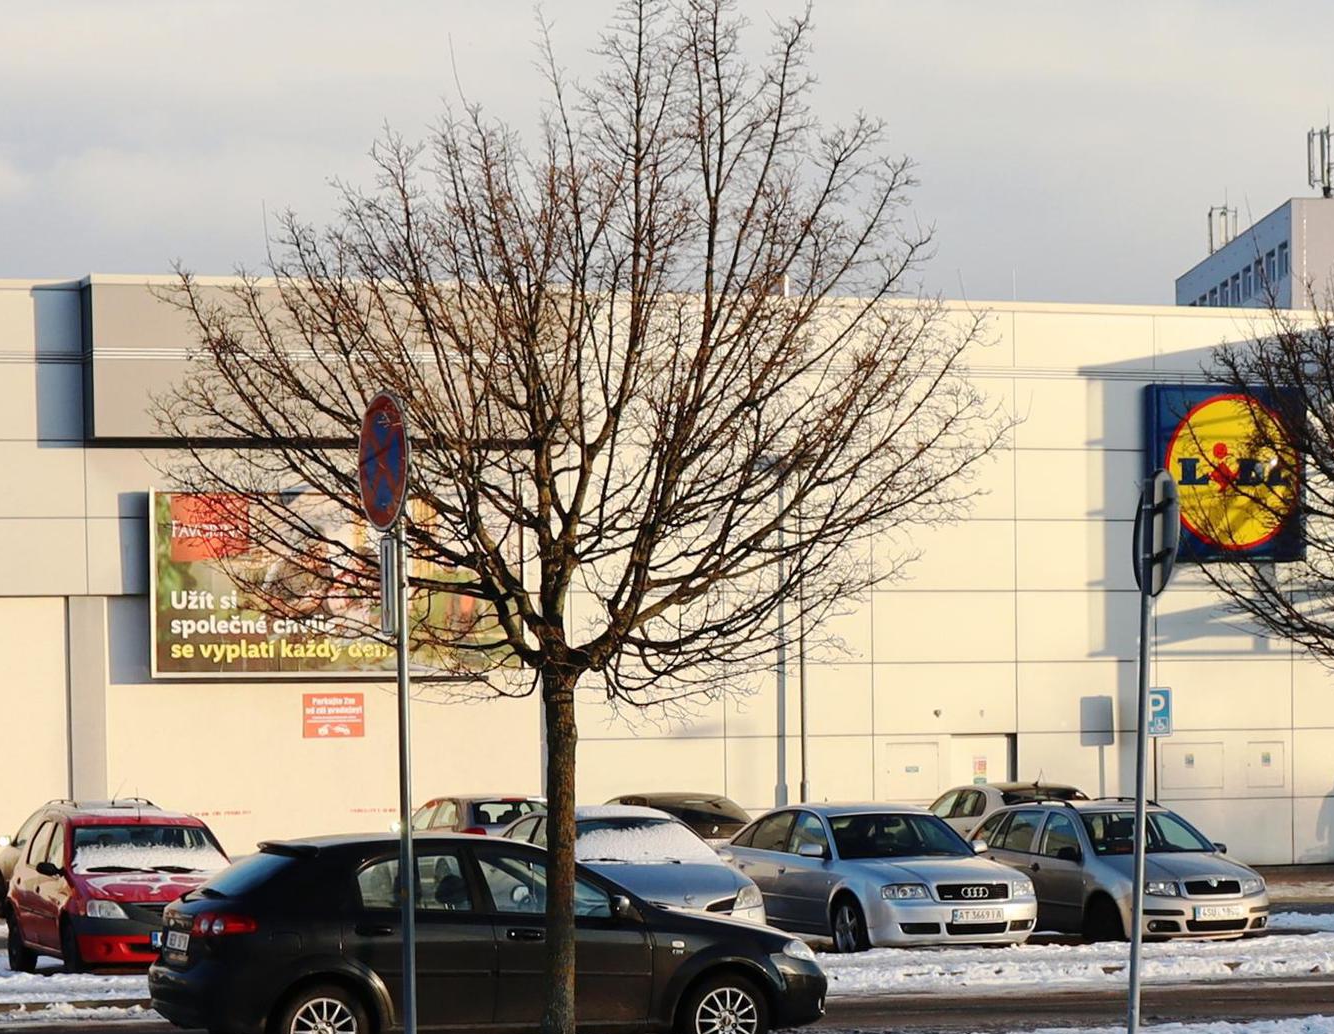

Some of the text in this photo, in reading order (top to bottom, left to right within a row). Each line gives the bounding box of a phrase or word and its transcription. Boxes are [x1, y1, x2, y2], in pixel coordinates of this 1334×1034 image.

[171, 590, 238, 610] Užít si
[171, 614, 267, 639] společné
[171, 643, 195, 659] se
[199, 639, 275, 663] vyplatí
